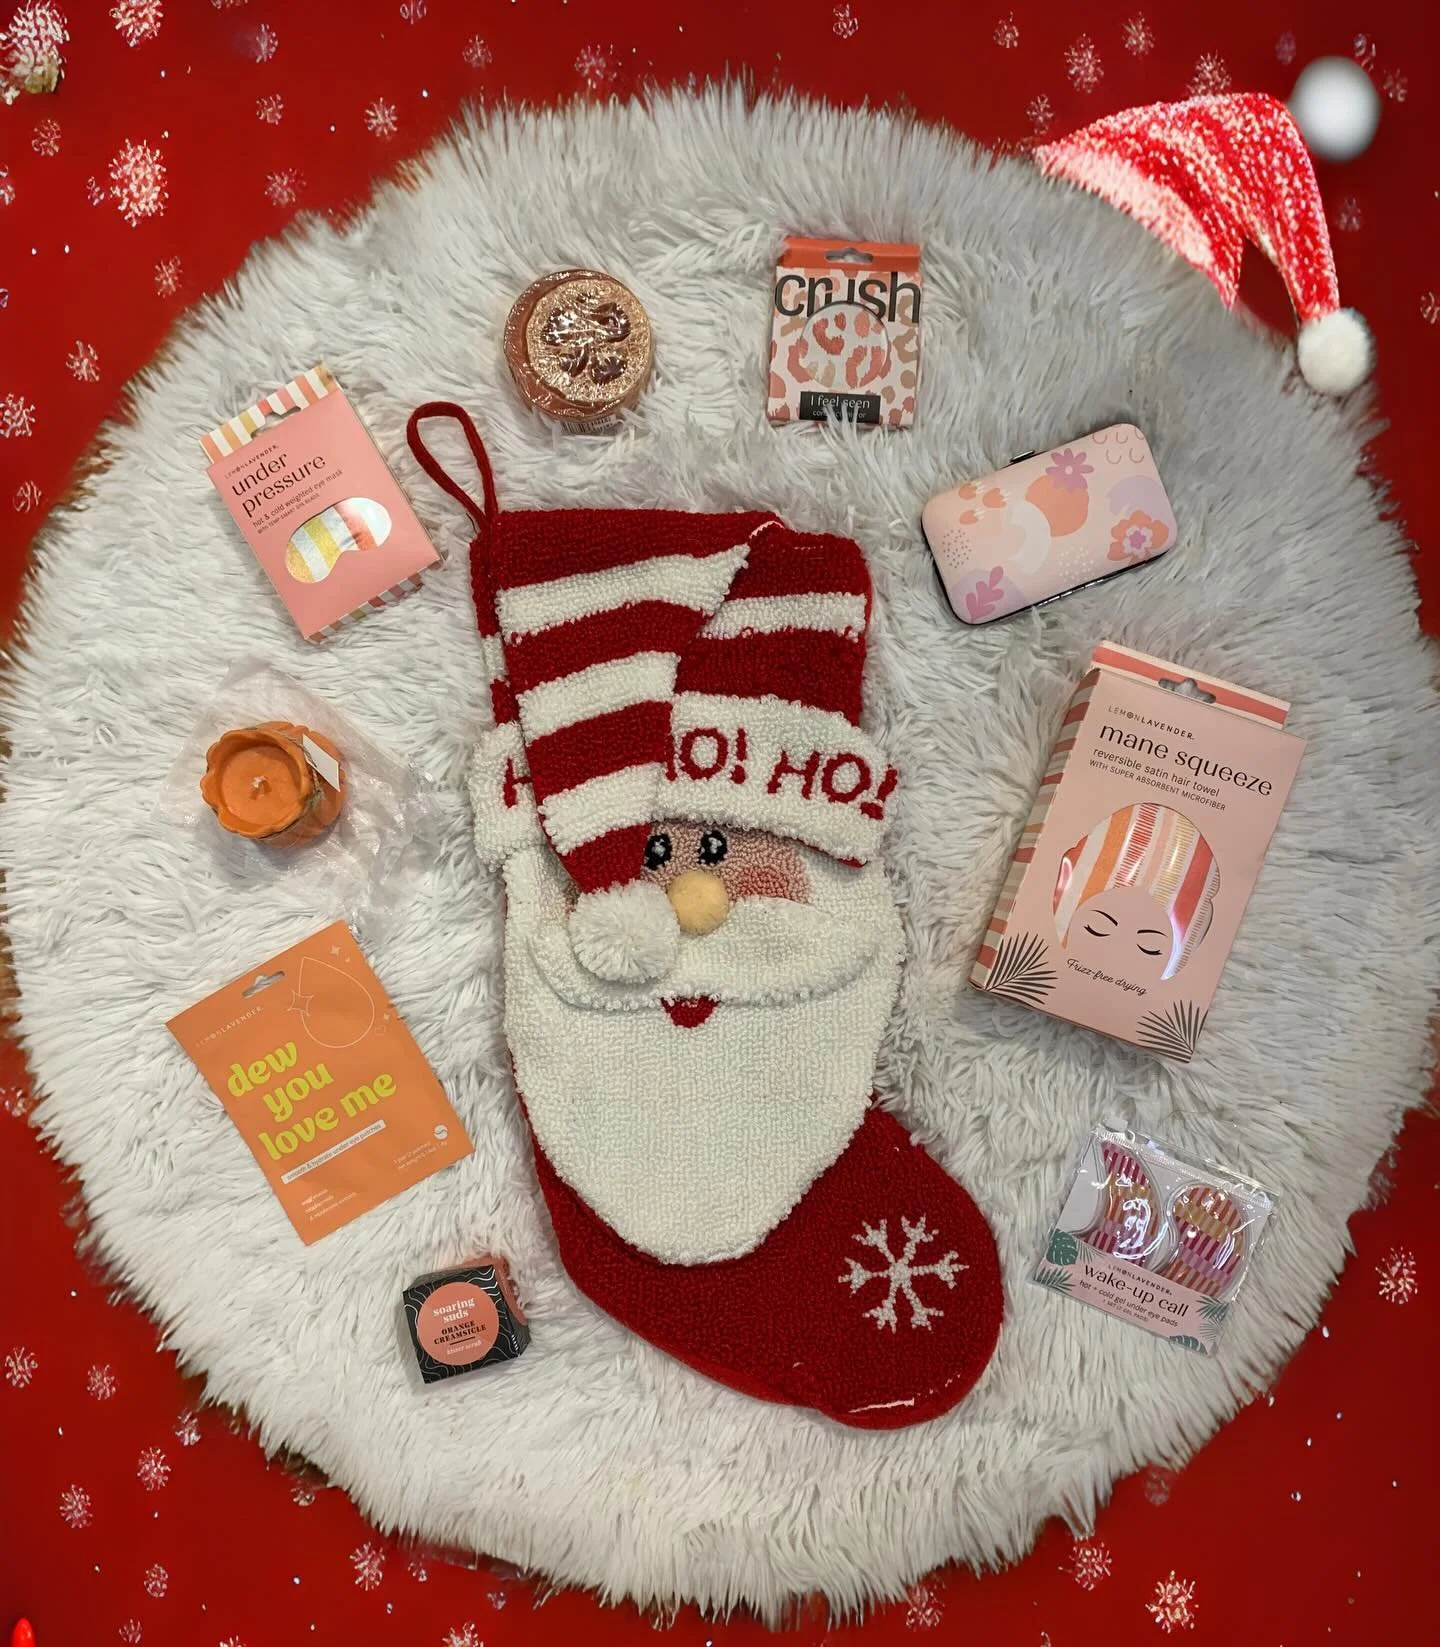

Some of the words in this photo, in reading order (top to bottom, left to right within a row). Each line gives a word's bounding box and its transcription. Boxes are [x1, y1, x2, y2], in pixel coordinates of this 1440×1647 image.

[774, 271, 922, 324] crush
[818, 394, 839, 407] feel
[842, 398, 870, 409] seen
[232, 453, 287, 496] under
[242, 456, 326, 518] pressure
[252, 517, 265, 528] hot
[264, 513, 270, 521] &
[270, 504, 286, 516] cold
[285, 486, 314, 508] weighted
[314, 480, 326, 490] eye
[326, 469, 344, 482] mask
[766, 750, 898, 820] HO!
[1089, 759, 1109, 770] WITH
[1110, 766, 1134, 779] SUPER
[1136, 776, 1180, 796] ABSORBENT
[1180, 790, 1226, 812] MICROFIBER
[1092, 748, 1142, 770] reversible
[1144, 764, 1169, 780] satin
[1170, 773, 1192, 787] hair
[1192, 780, 1220, 797] towel
[1099, 724, 1169, 760] mane
[1174, 750, 1273, 797] squeeze
[1066, 958, 1114, 983] Frizz-free
[1114, 978, 1146, 996] drying
[227, 1041, 298, 1097] dew
[262, 1063, 334, 1123] you
[258, 1106, 340, 1161] love
[340, 1073, 398, 1118] me
[432, 1297, 476, 1316] soaring
[443, 1309, 469, 1323] suds
[1080, 1280, 1092, 1290] hot
[1098, 1288, 1114, 1300] cold
[1115, 1296, 1126, 1305] gel
[1126, 1300, 1148, 1314] under
[1148, 1310, 1160, 1320] eye
[1160, 1316, 1178, 1328] pads
[1084, 1264, 1154, 1304] wake-up
[1158, 1299, 1189, 1317] call
[434, 1324, 487, 1345] CREAMSICLE
[441, 1320, 476, 1336] ORANGE
